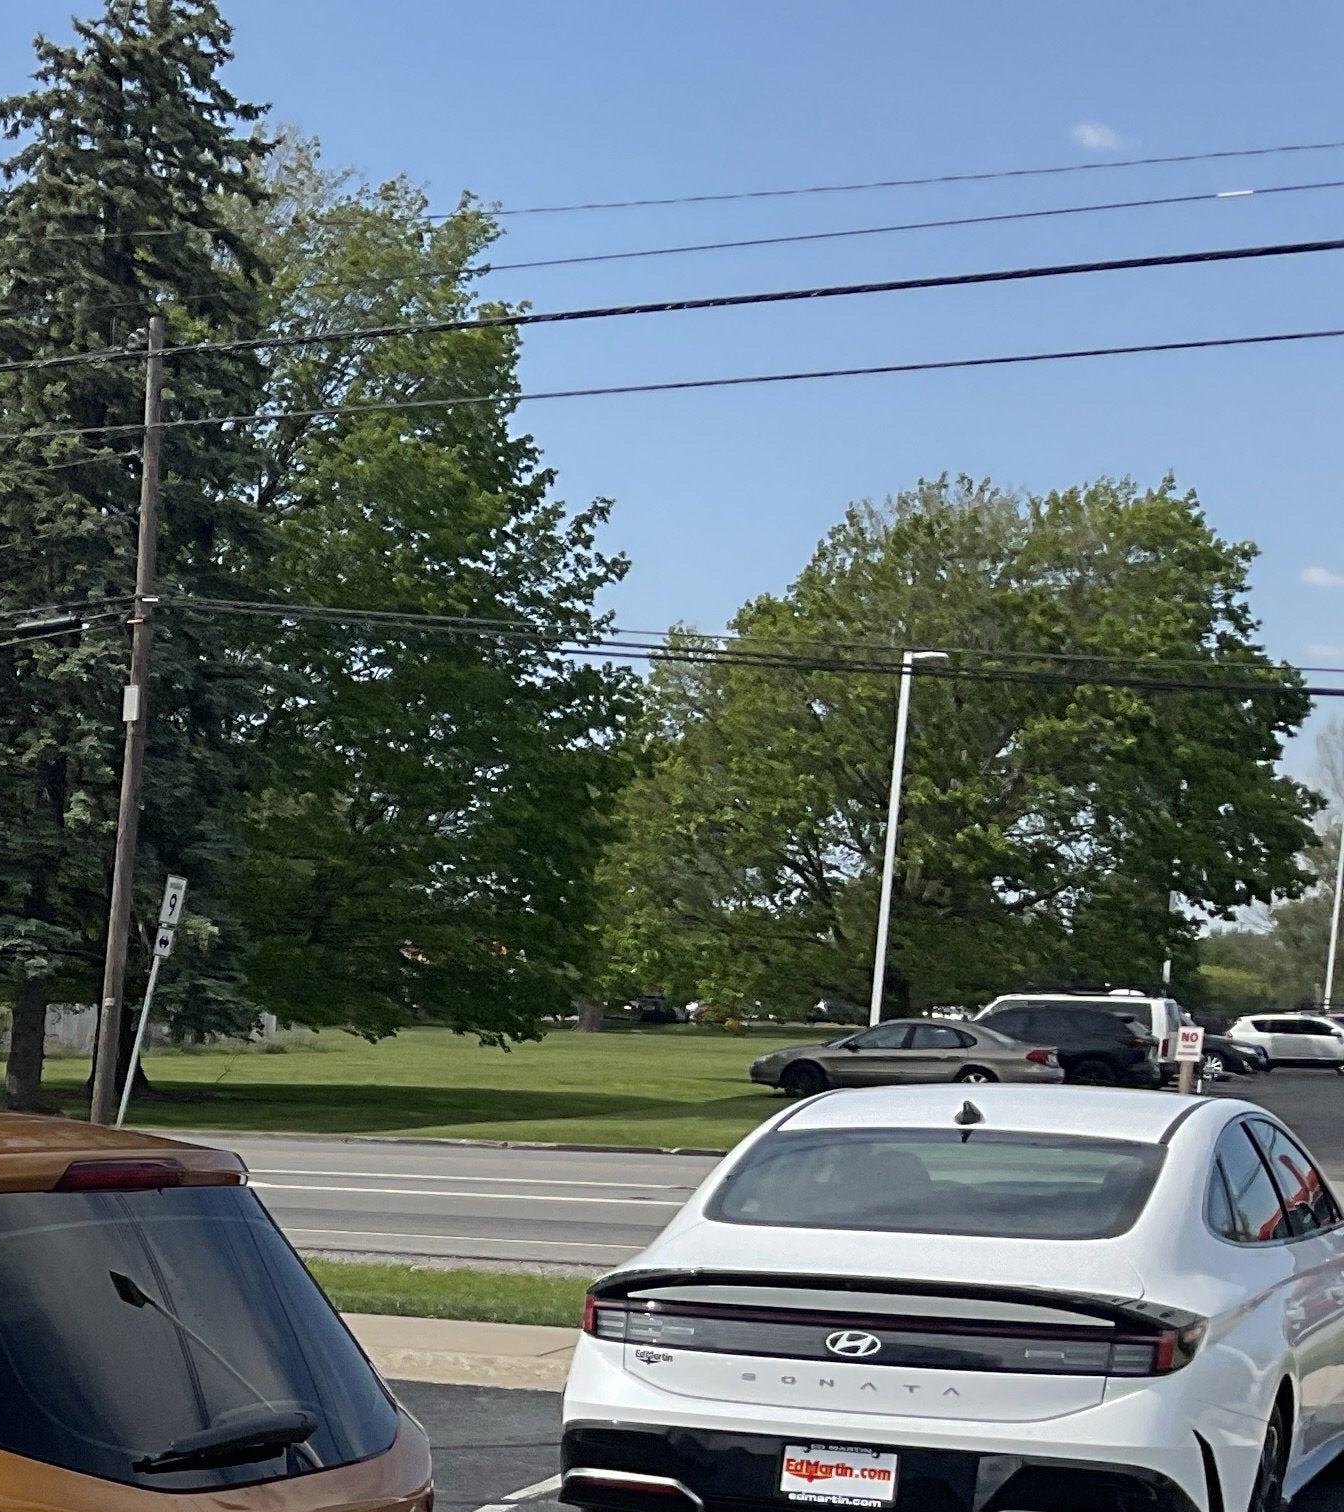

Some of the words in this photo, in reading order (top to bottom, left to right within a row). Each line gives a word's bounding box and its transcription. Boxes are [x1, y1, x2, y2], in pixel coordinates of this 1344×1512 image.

[168, 893, 178, 917] 9
[1181, 1032, 1199, 1042] NO
[741, 1372, 961, 1397] SONATA
[784, 1457, 892, 1482] EdMartin.com
[787, 1492, 882, 1508] edmartin.com
